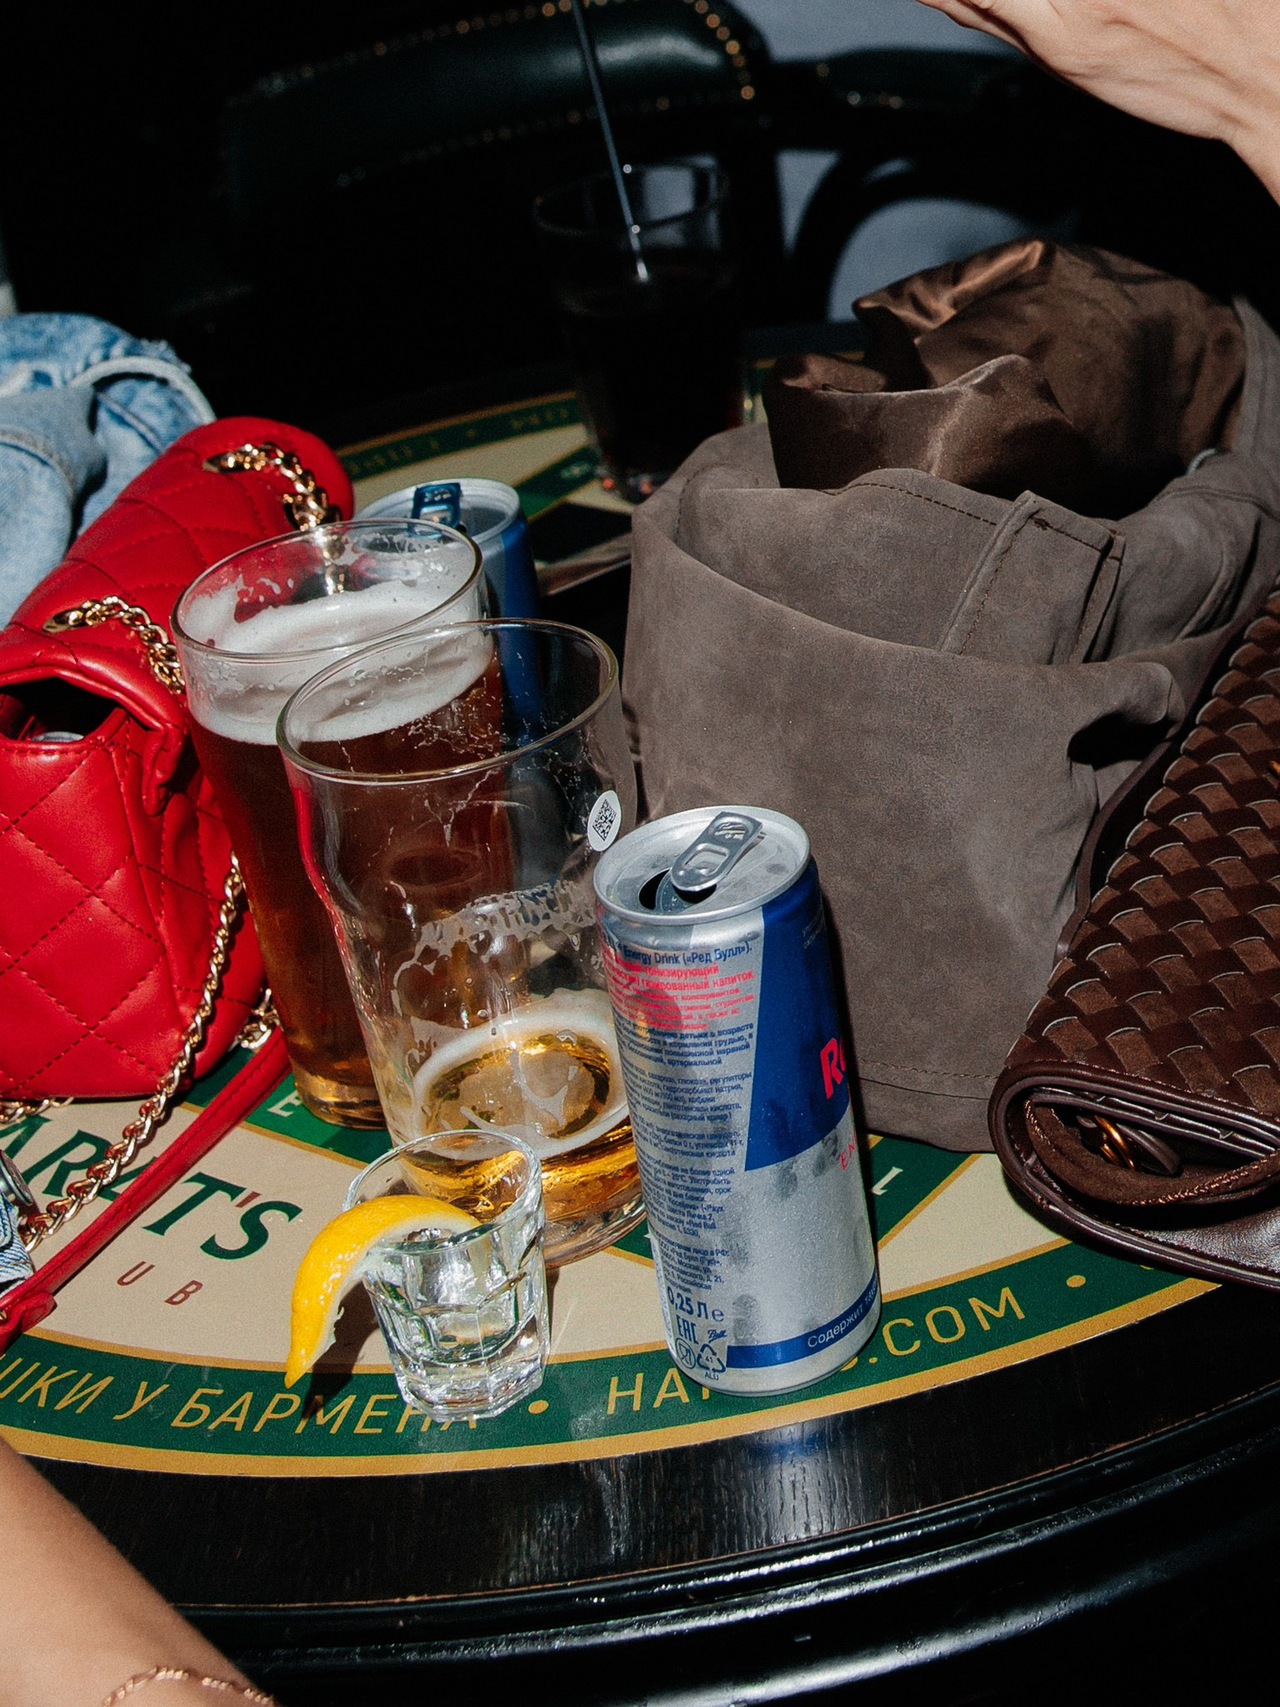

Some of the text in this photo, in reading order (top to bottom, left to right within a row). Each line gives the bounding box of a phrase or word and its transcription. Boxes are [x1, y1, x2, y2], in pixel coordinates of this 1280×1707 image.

[644, 963, 719, 980] тонизирующий
[654, 952, 681, 964] Drink
[683, 952, 712, 965] («Ред
[717, 1022, 754, 1036] возрасте
[667, 1286, 694, 1316] 0,25
[676, 1315, 699, 1345] EAC
[807, 1304, 864, 1348] Содержит
[113, 1381, 169, 1420] У
[171, 1388, 476, 1434] БАРМЕН
